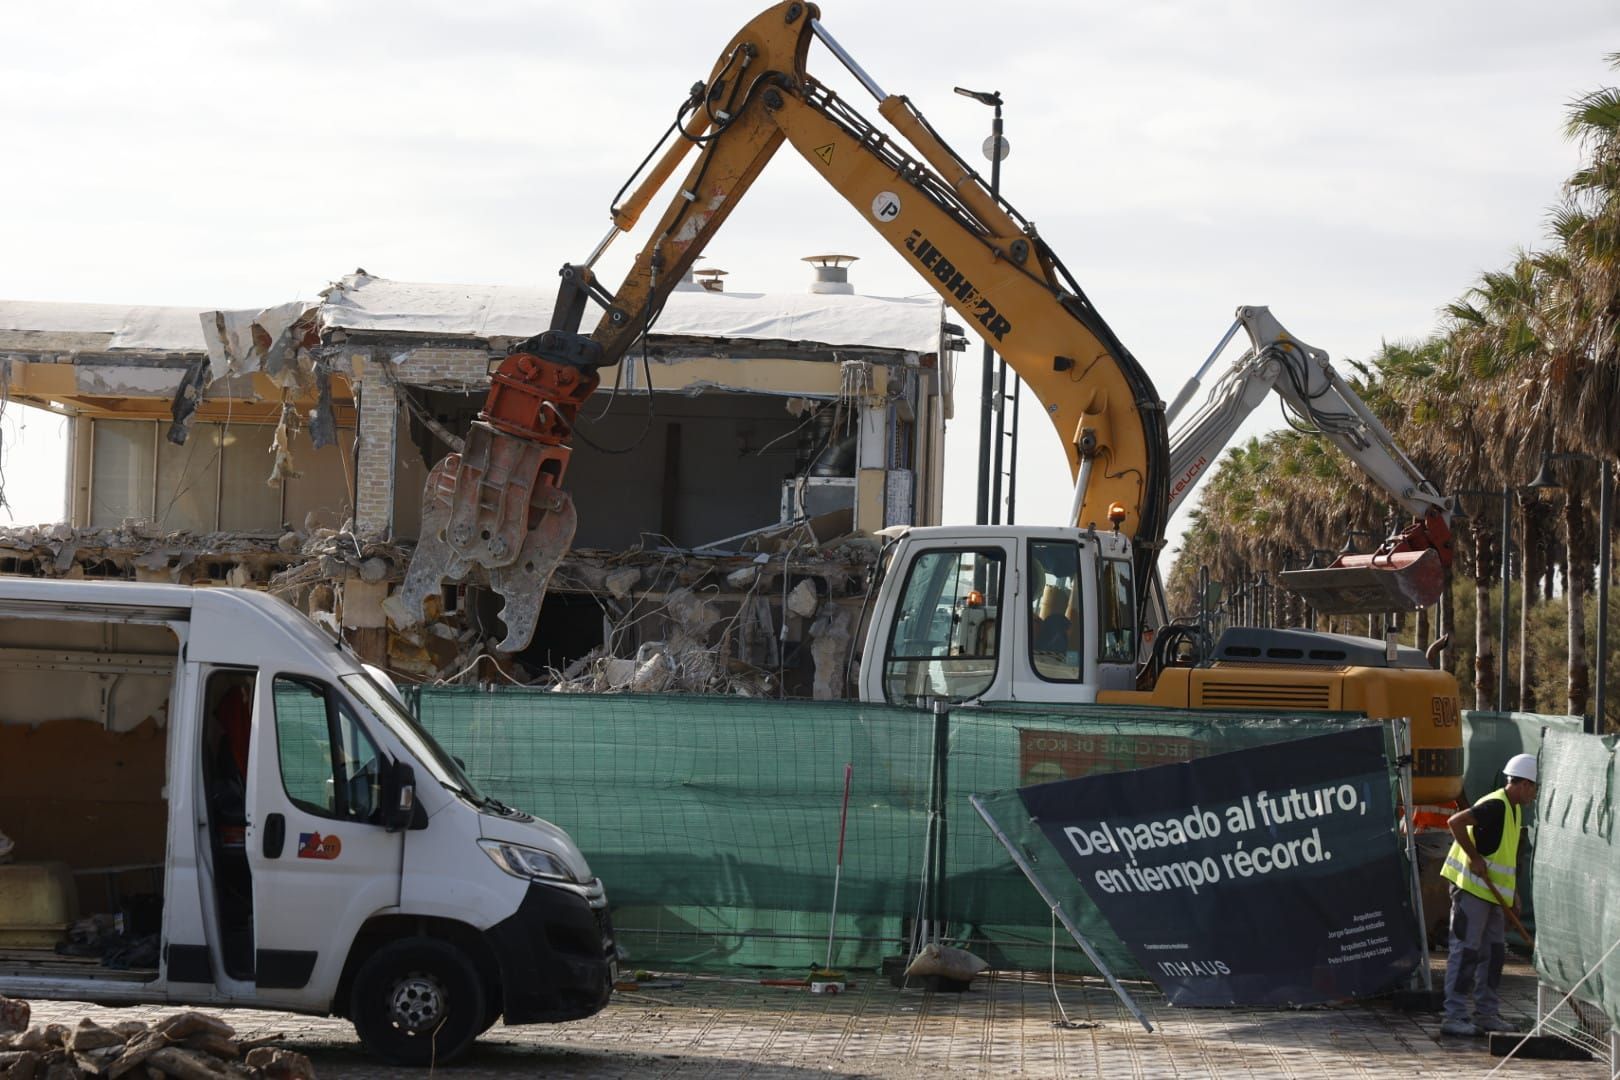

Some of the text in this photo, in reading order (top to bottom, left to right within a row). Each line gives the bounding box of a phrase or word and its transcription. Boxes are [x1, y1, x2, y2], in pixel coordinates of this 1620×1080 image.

[1063, 783, 1367, 860] Del pasado al futuro,
[1095, 828, 1331, 894] en tiempo récord.
